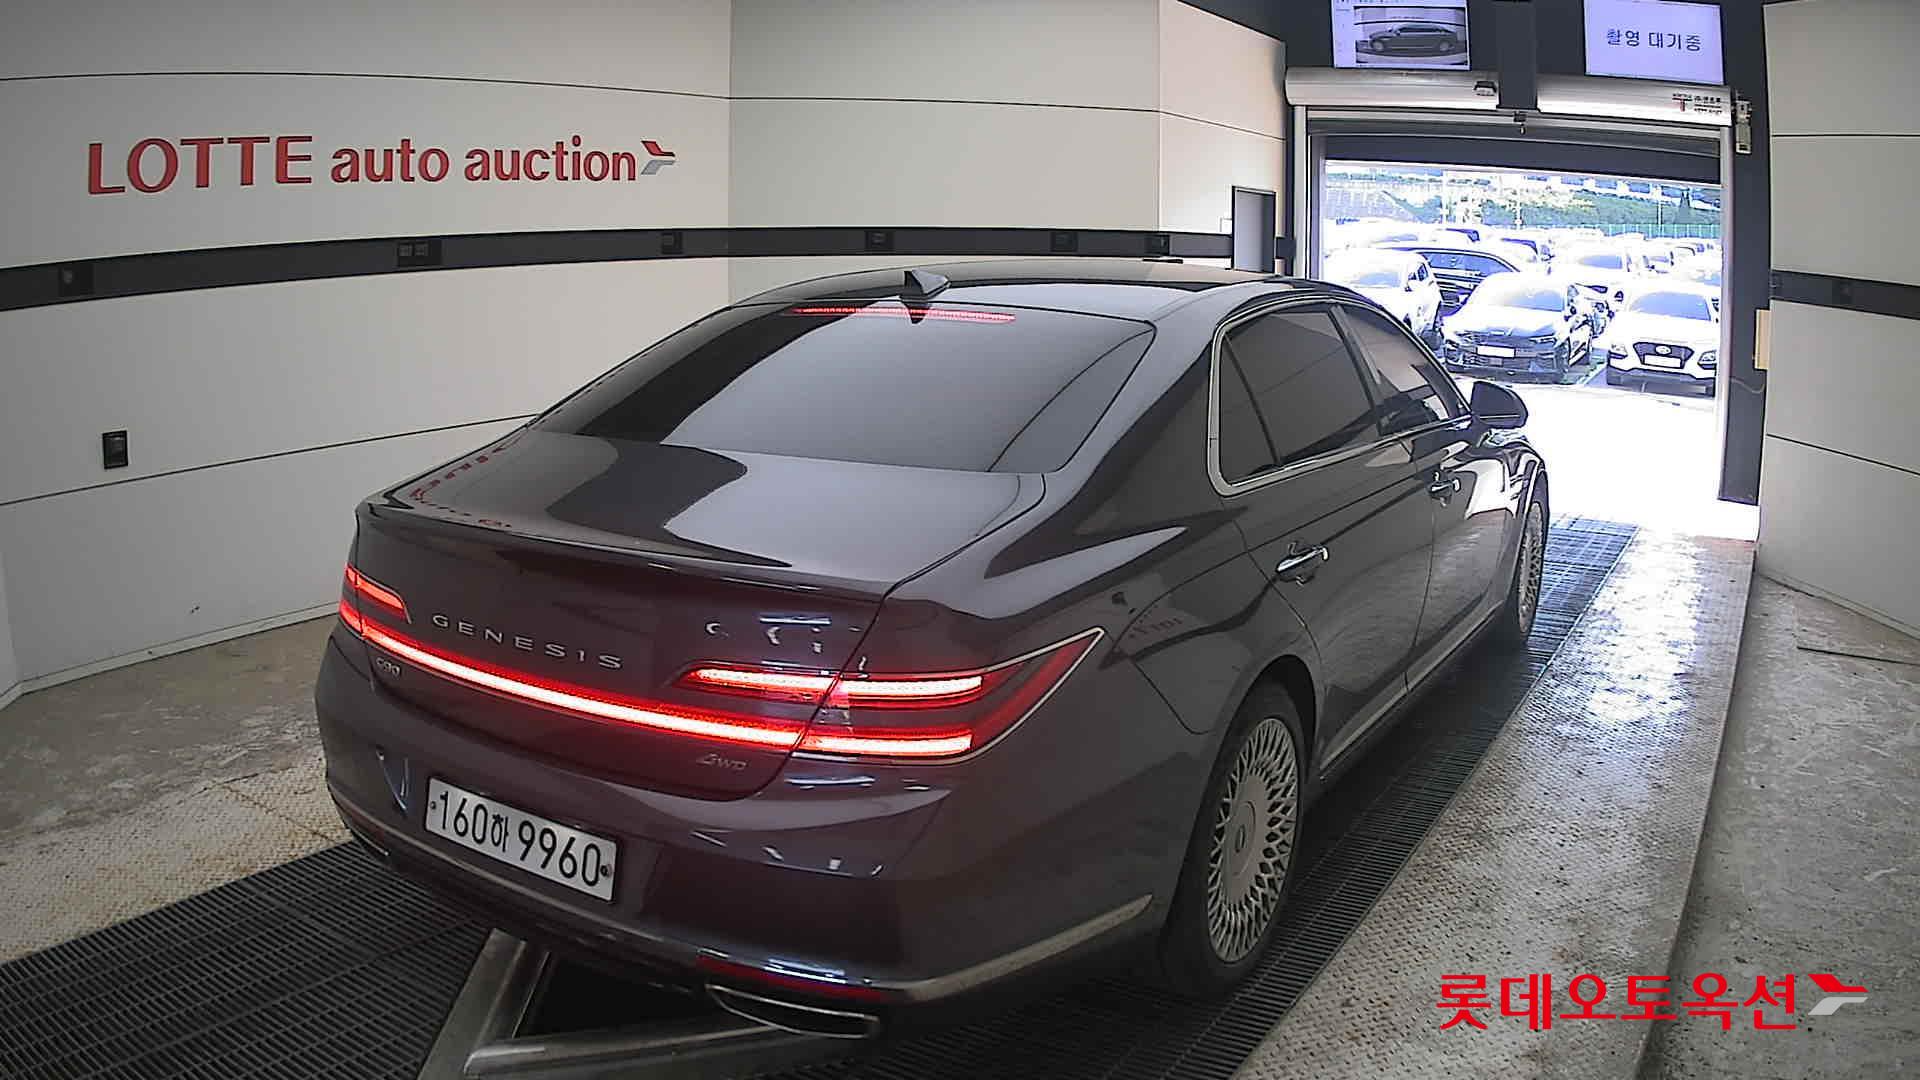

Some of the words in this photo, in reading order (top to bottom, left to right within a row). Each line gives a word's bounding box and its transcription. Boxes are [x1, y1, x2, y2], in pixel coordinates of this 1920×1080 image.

[1607, 28, 1640, 47] 촬영
[1648, 32, 1701, 52] 대기중
[87, 135, 314, 196] LOTTE
[330, 138, 450, 184] auto
[464, 135, 638, 182] auction
[432, 613, 623, 669] GENESIS
[439, 790, 509, 853] 160하
[518, 819, 602, 887] 9960
